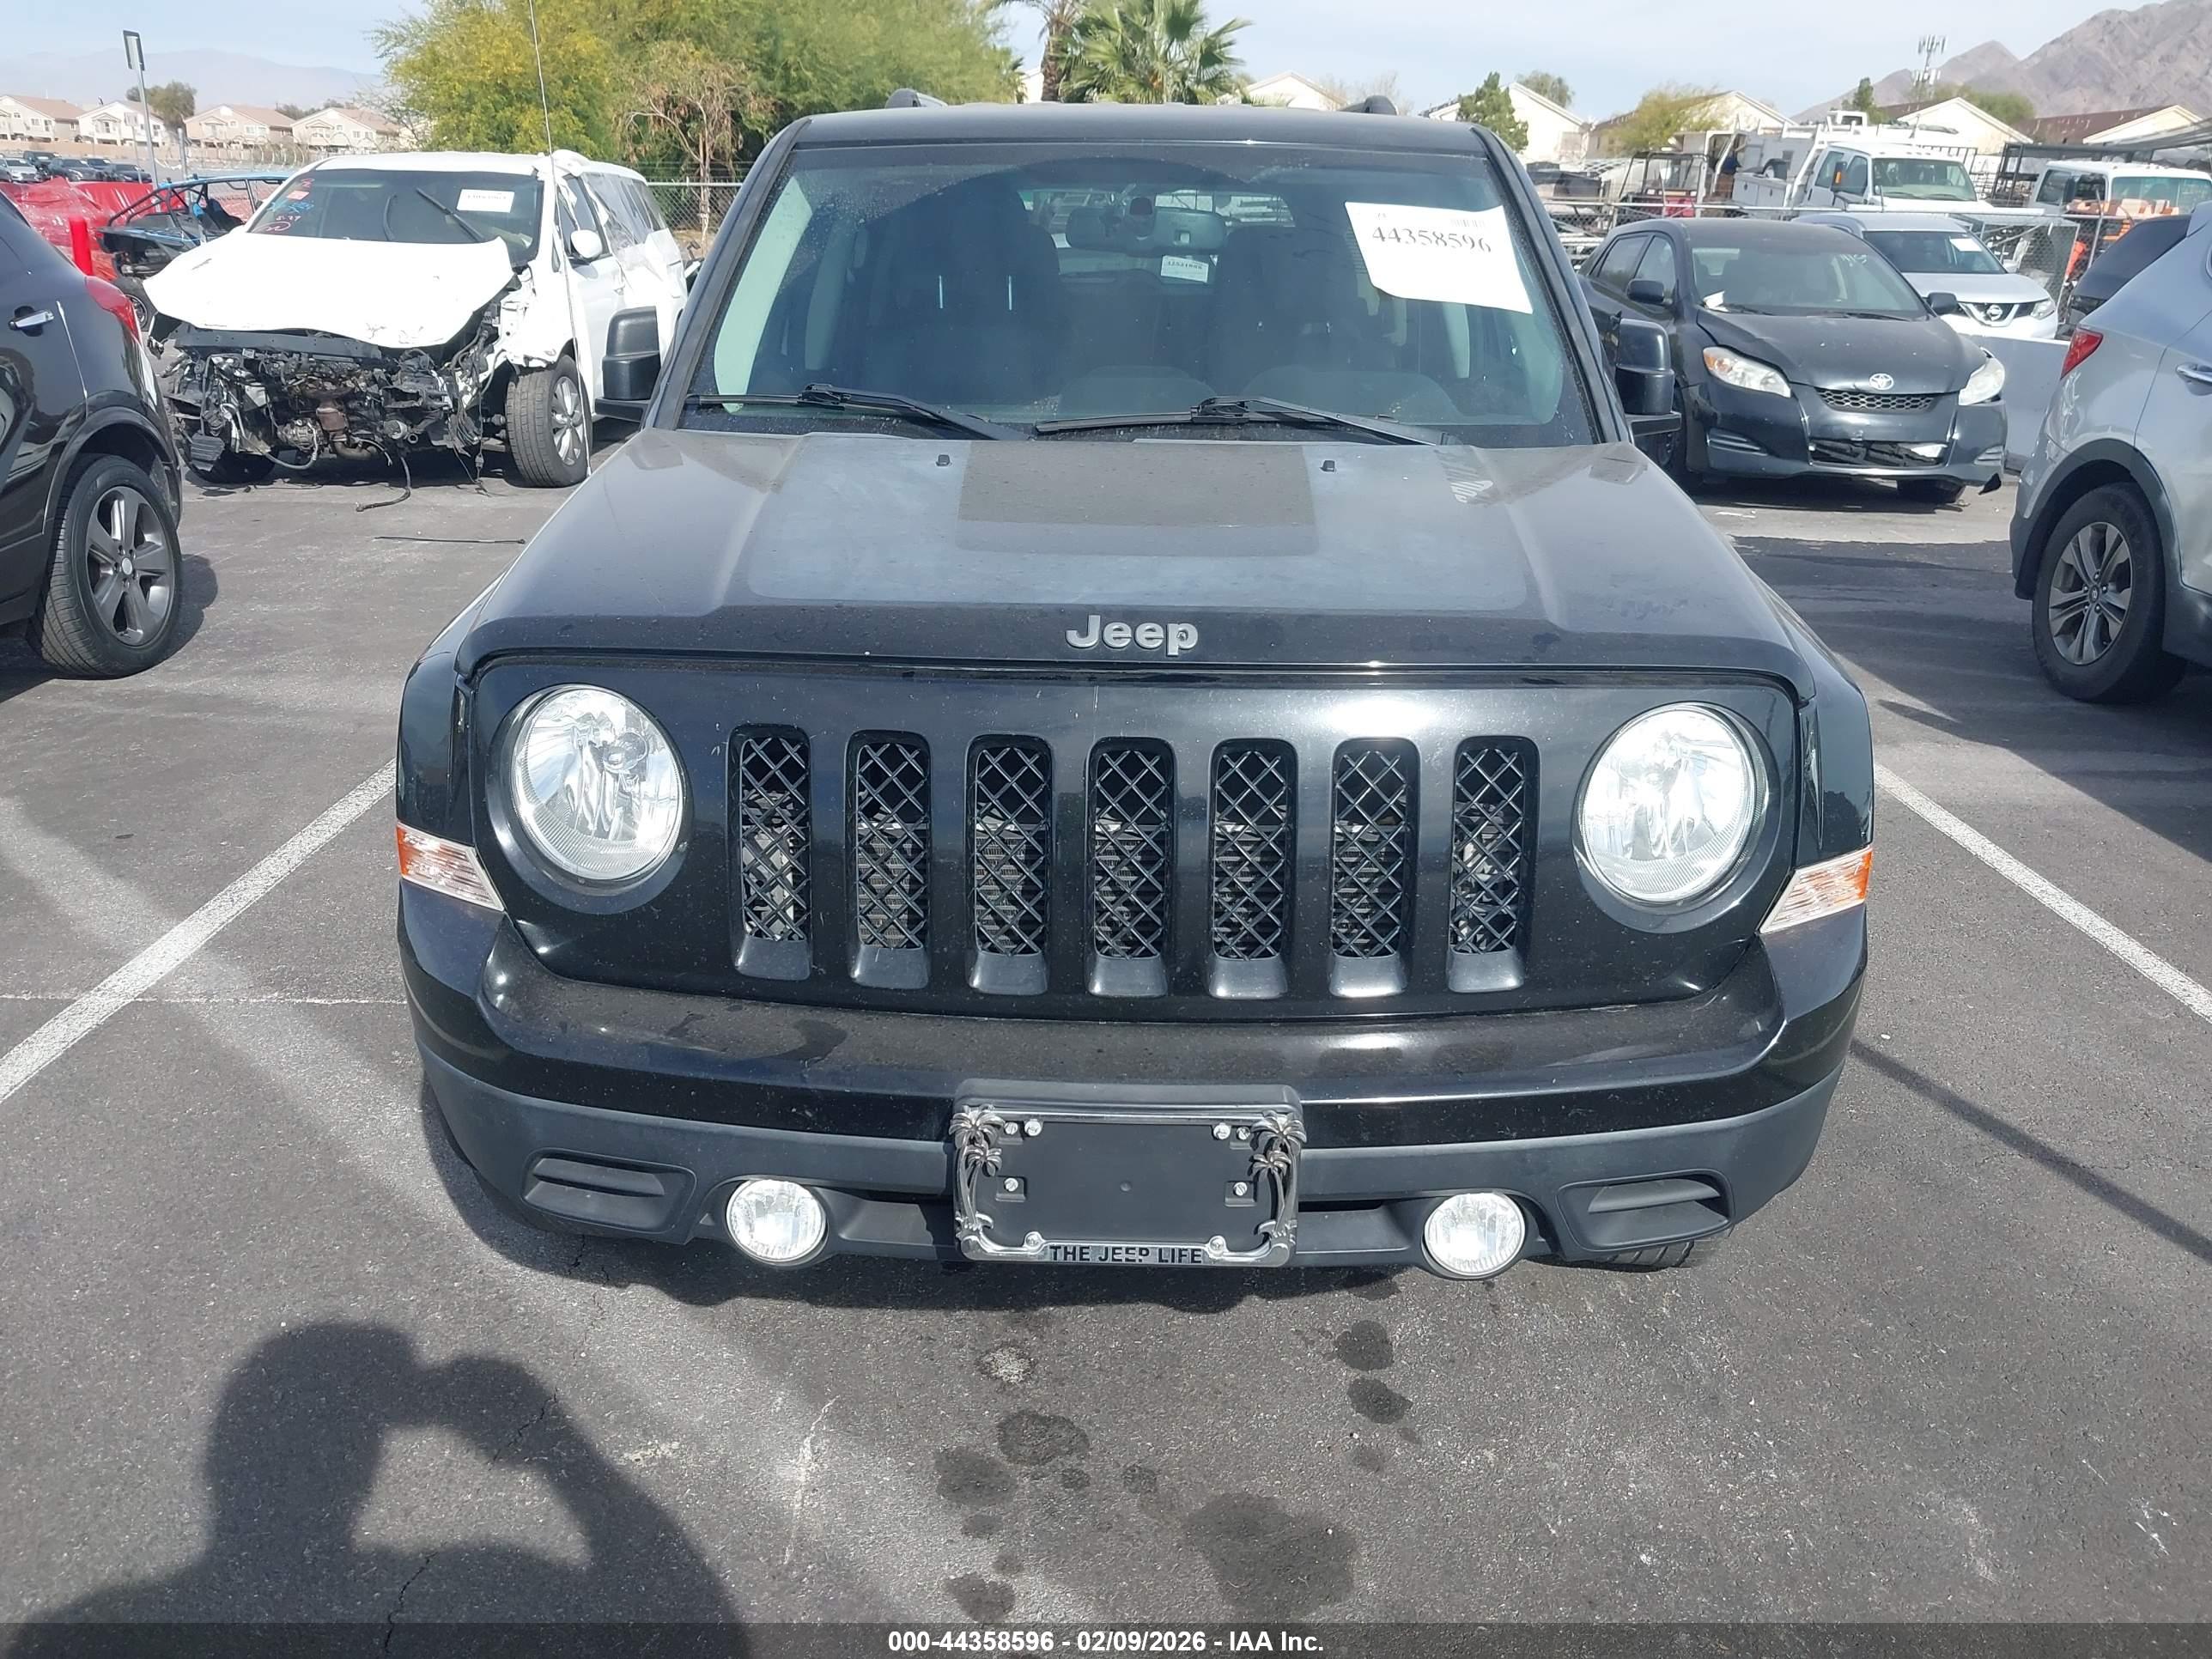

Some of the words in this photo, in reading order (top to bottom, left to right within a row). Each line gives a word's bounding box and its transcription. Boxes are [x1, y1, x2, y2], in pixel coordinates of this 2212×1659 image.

[1371, 226, 1492, 253] 44358596
[1066, 614, 1199, 656] Jeep
[1049, 1245, 1091, 1261] THE
[1098, 1246, 1150, 1263] JEEP
[1158, 1248, 1202, 1264] LIFE
